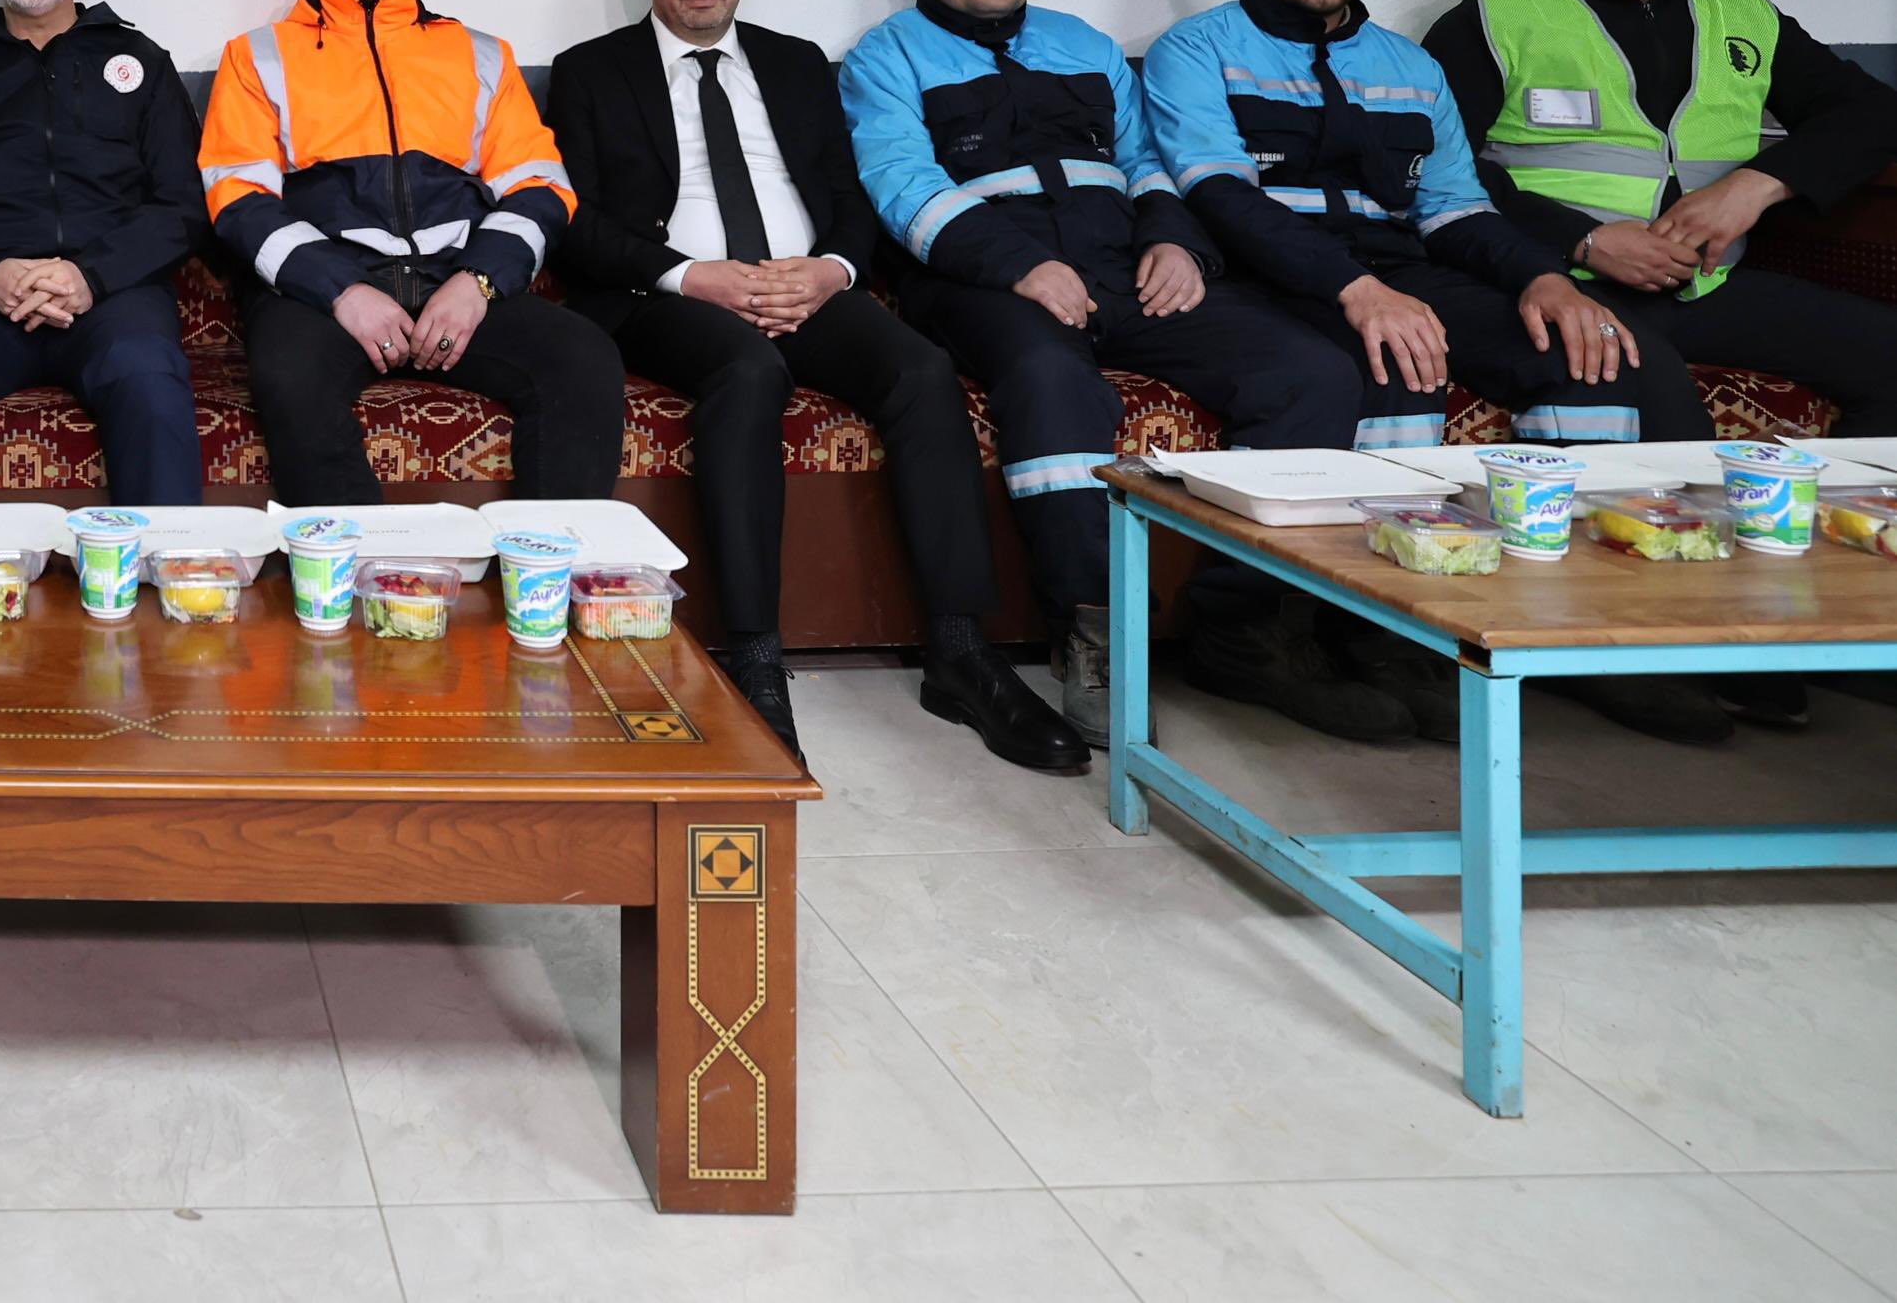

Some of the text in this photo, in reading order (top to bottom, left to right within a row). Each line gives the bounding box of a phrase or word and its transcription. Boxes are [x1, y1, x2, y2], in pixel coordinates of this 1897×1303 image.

[1490, 451, 1568, 464] Ayran
[1540, 497, 1575, 516] Ayra
[529, 579, 568, 603] Ayran
